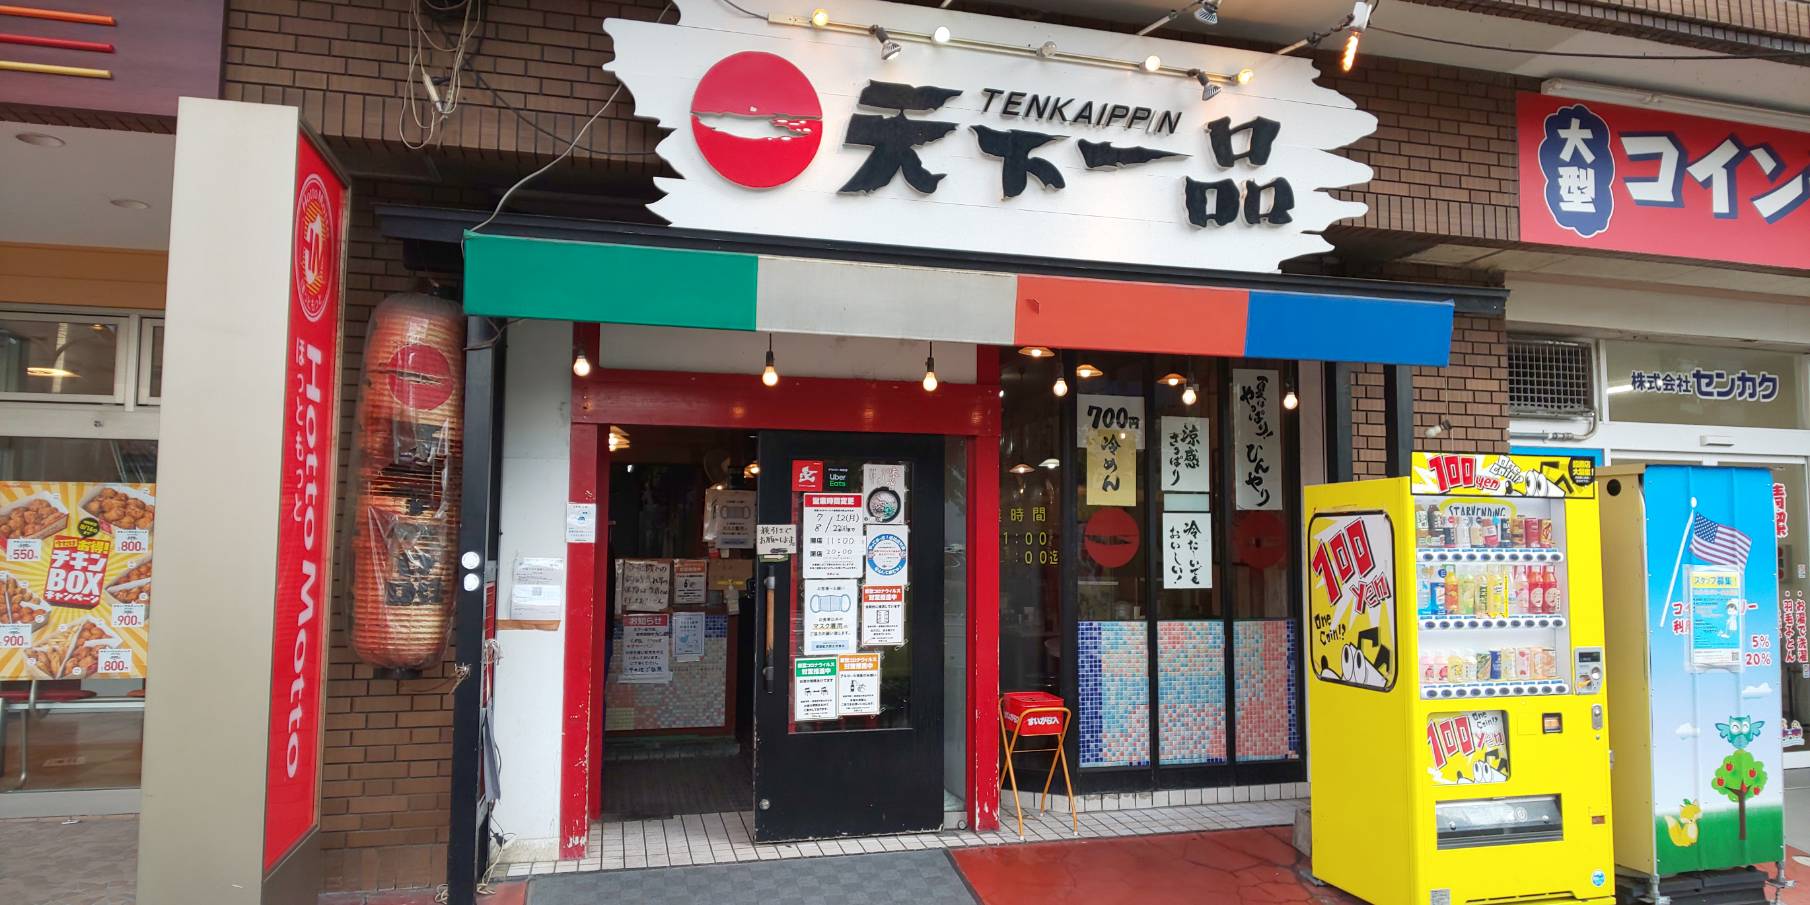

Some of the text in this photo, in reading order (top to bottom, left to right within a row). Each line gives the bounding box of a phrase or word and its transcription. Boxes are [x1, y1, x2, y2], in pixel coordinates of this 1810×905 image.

[981, 87, 1182, 134] TENKAIPPIN
[837, 79, 1295, 228] 天下一品
[1557, 117, 1597, 213] 大型
[1631, 368, 1778, 401] 株式会社センカク
[293, 337, 305, 522] ほっともっと
[1087, 404, 1140, 430] 700円
[303, 344, 322, 550] Hotto
[1100, 433, 1121, 493] 冷めん
[1169, 431, 1184, 487] さっぱり
[1180, 422, 1201, 469] 涼感
[829, 473, 847, 481] Uber
[1245, 444, 1270, 507] ひんやり
[1428, 454, 1476, 494] 100
[46, 567, 104, 597] BOX
[51, 549, 108, 572] チキン
[1312, 517, 1376, 607] 100
[45, 590, 99, 604] キャンペーン
[632, 617, 662, 625] お知らせ
[1314, 613, 1332, 630] One
[1752, 635, 1770, 648] 5%
[1783, 599, 1796, 663] 羽毛ふとん
[286, 559, 318, 779] Motto
[1745, 653, 1771, 666] 20%
[1427, 716, 1475, 770] 100
